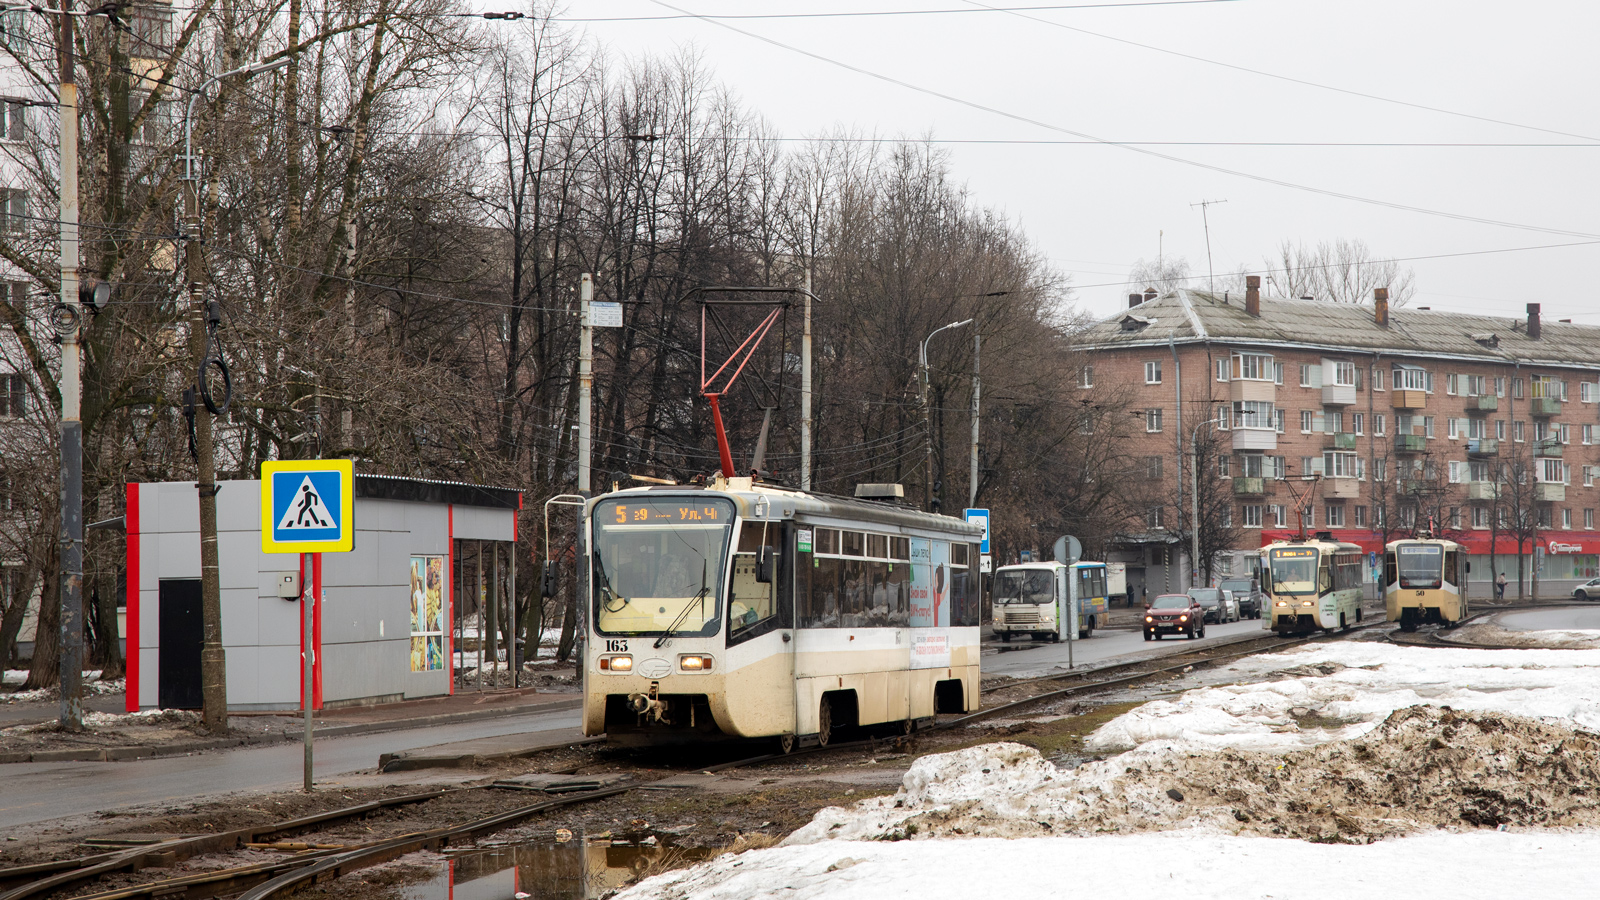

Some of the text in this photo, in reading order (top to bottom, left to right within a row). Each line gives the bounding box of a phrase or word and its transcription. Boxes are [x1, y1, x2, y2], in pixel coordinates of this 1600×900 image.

[616, 506, 627, 523] 5
[679, 507, 702, 520] Ул.
[606, 639, 628, 652] 163
